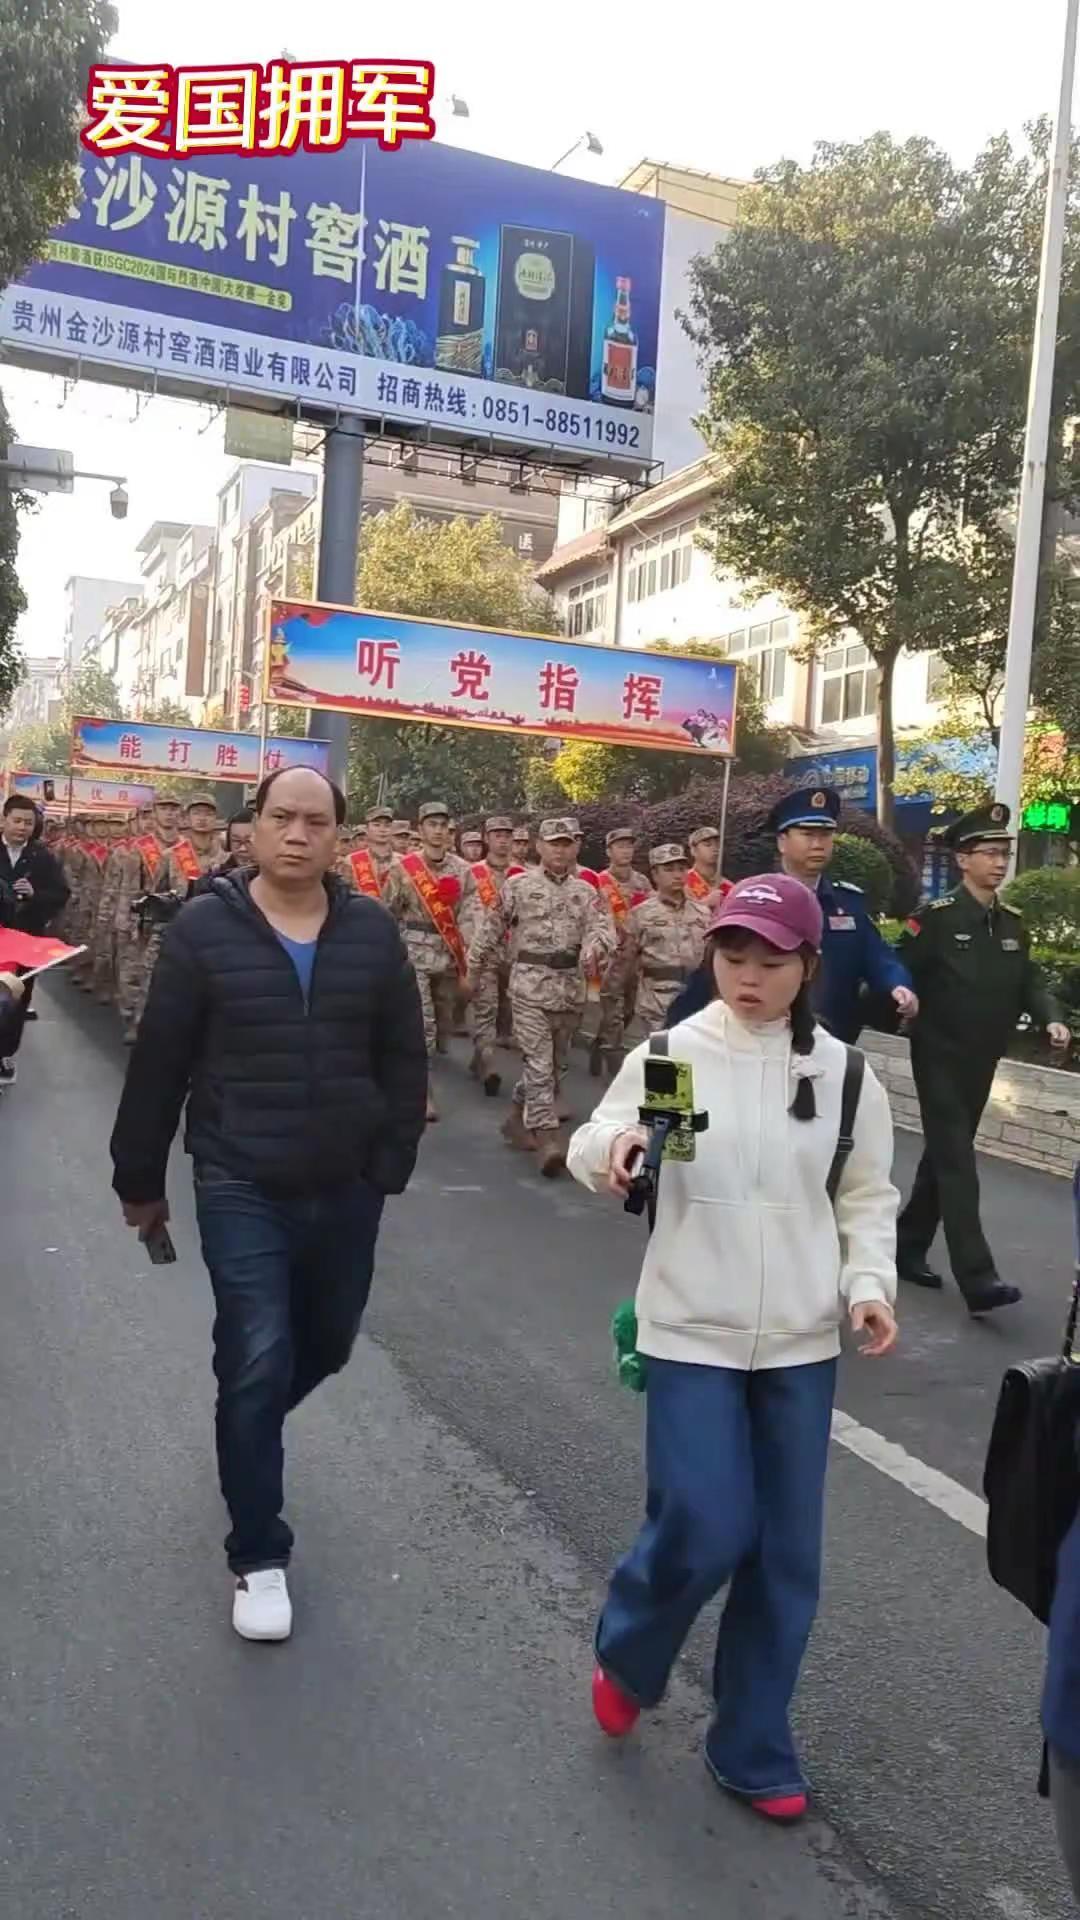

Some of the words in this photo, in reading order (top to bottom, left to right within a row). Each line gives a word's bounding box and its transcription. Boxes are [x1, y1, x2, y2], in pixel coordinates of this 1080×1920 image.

[67, 156, 430, 300] 沙源村窖酒
[12, 299, 357, 397] 贵州金沙源村窖酒酒业有限公司
[357, 638, 664, 723] 听党指挥
